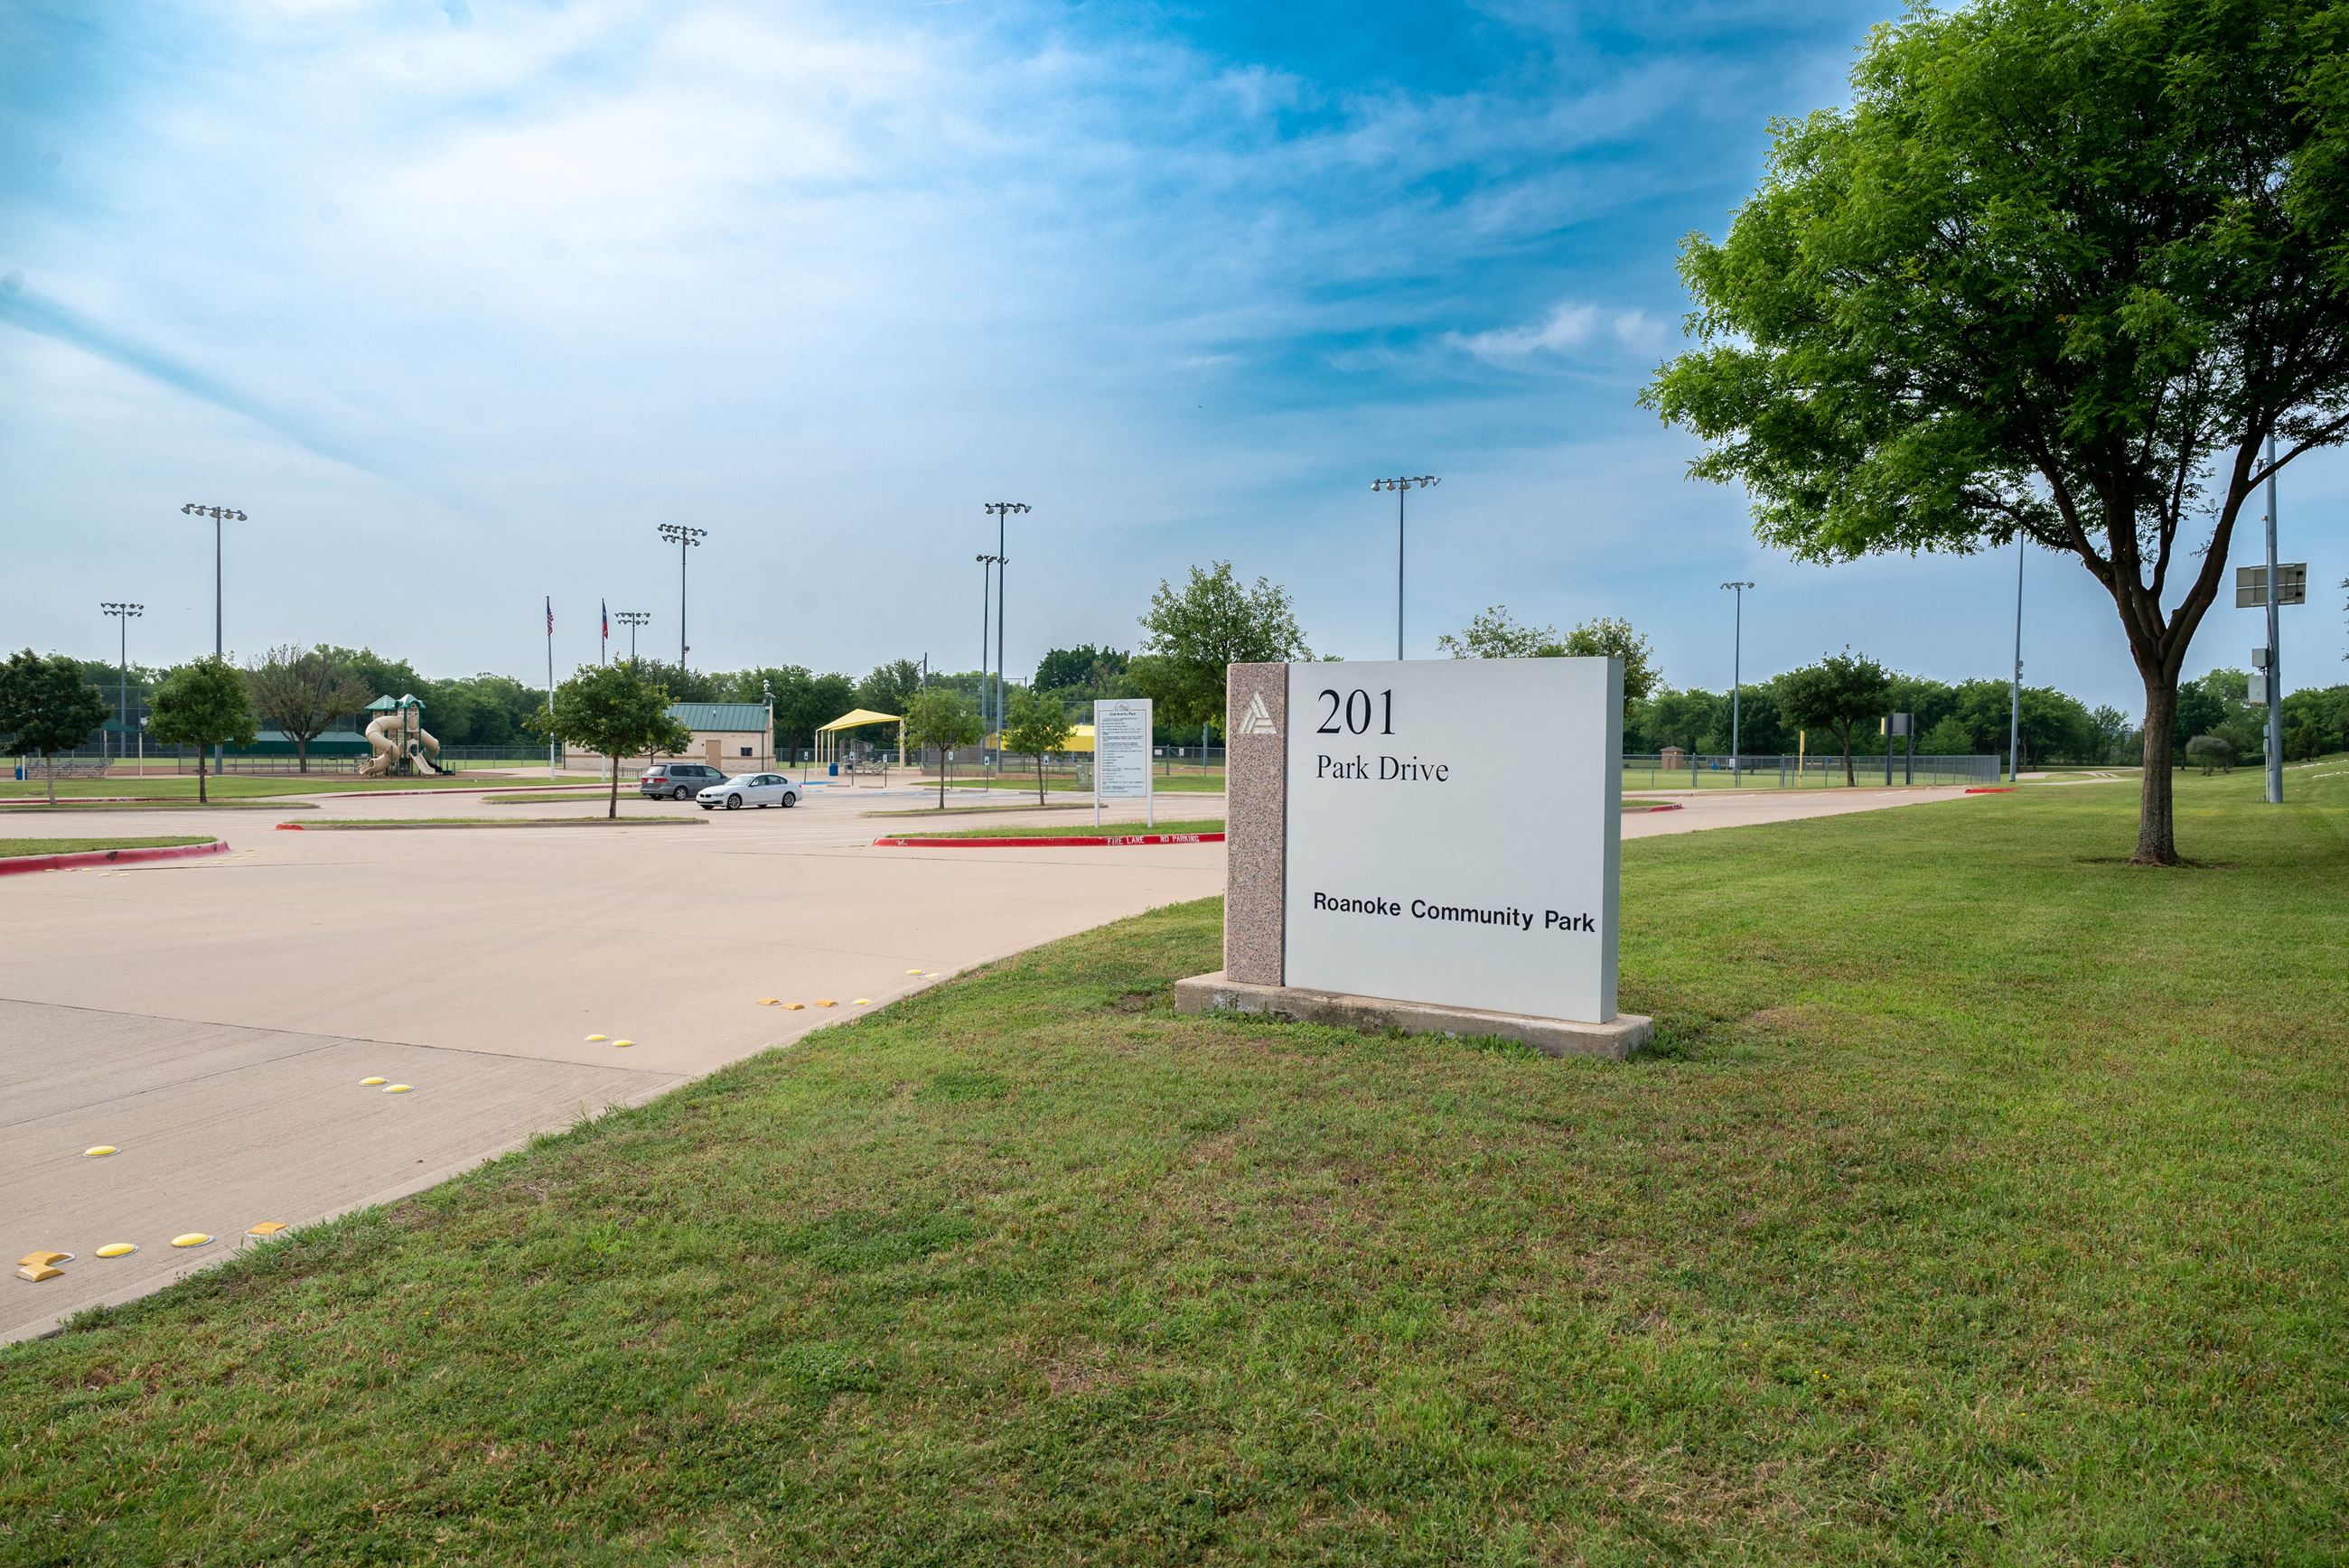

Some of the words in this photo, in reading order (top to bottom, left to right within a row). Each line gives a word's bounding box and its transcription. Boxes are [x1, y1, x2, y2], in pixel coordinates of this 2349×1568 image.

[1315, 688, 1396, 735] 201
[1316, 754, 1370, 779] Park
[1379, 755, 1449, 782] Drive
[1107, 837, 1123, 845] FIRE
[1127, 835, 1145, 844] LANE
[1172, 835, 1200, 843] PARKING
[1314, 891, 1401, 917] Roanoke
[1410, 899, 1534, 931] Community
[1545, 910, 1596, 933] Park
